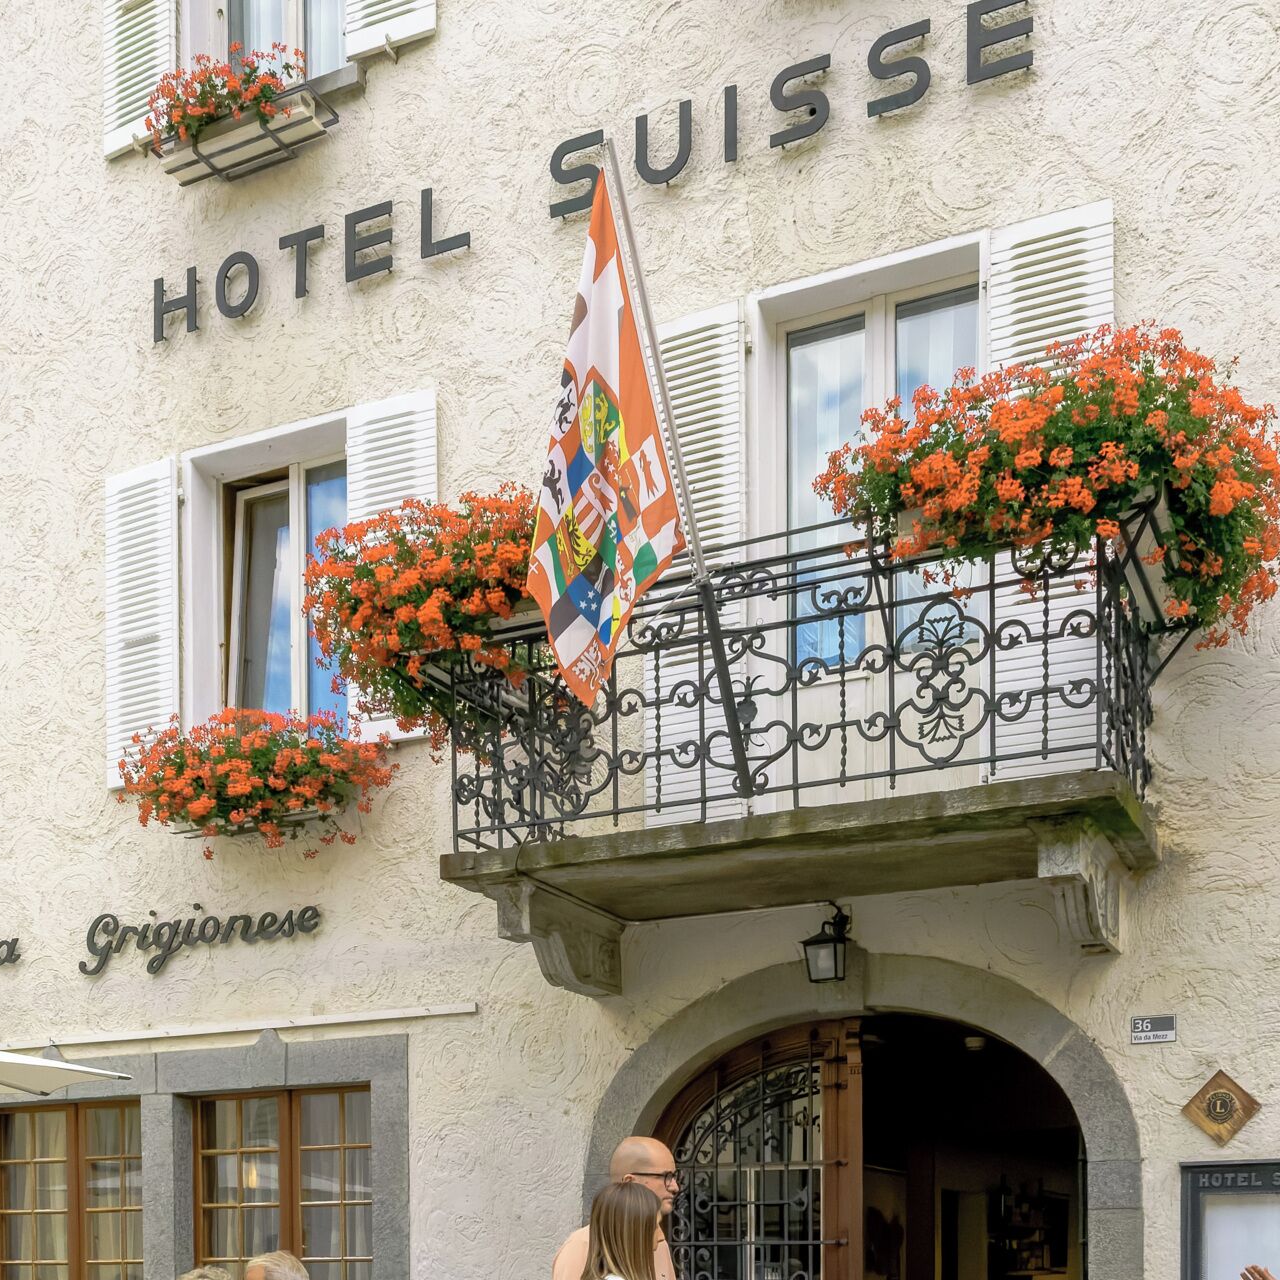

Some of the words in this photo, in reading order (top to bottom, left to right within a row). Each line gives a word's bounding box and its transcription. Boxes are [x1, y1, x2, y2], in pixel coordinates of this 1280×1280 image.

[152, 187, 471, 343] HOTEL
[549, 0, 1034, 219] SUISSE
[78, 902, 322, 977] Grigionese
[1134, 1019, 1151, 1032] 36
[1215, 1100, 1225, 1112] L
[1199, 1172, 1262, 1187] HOTEL
